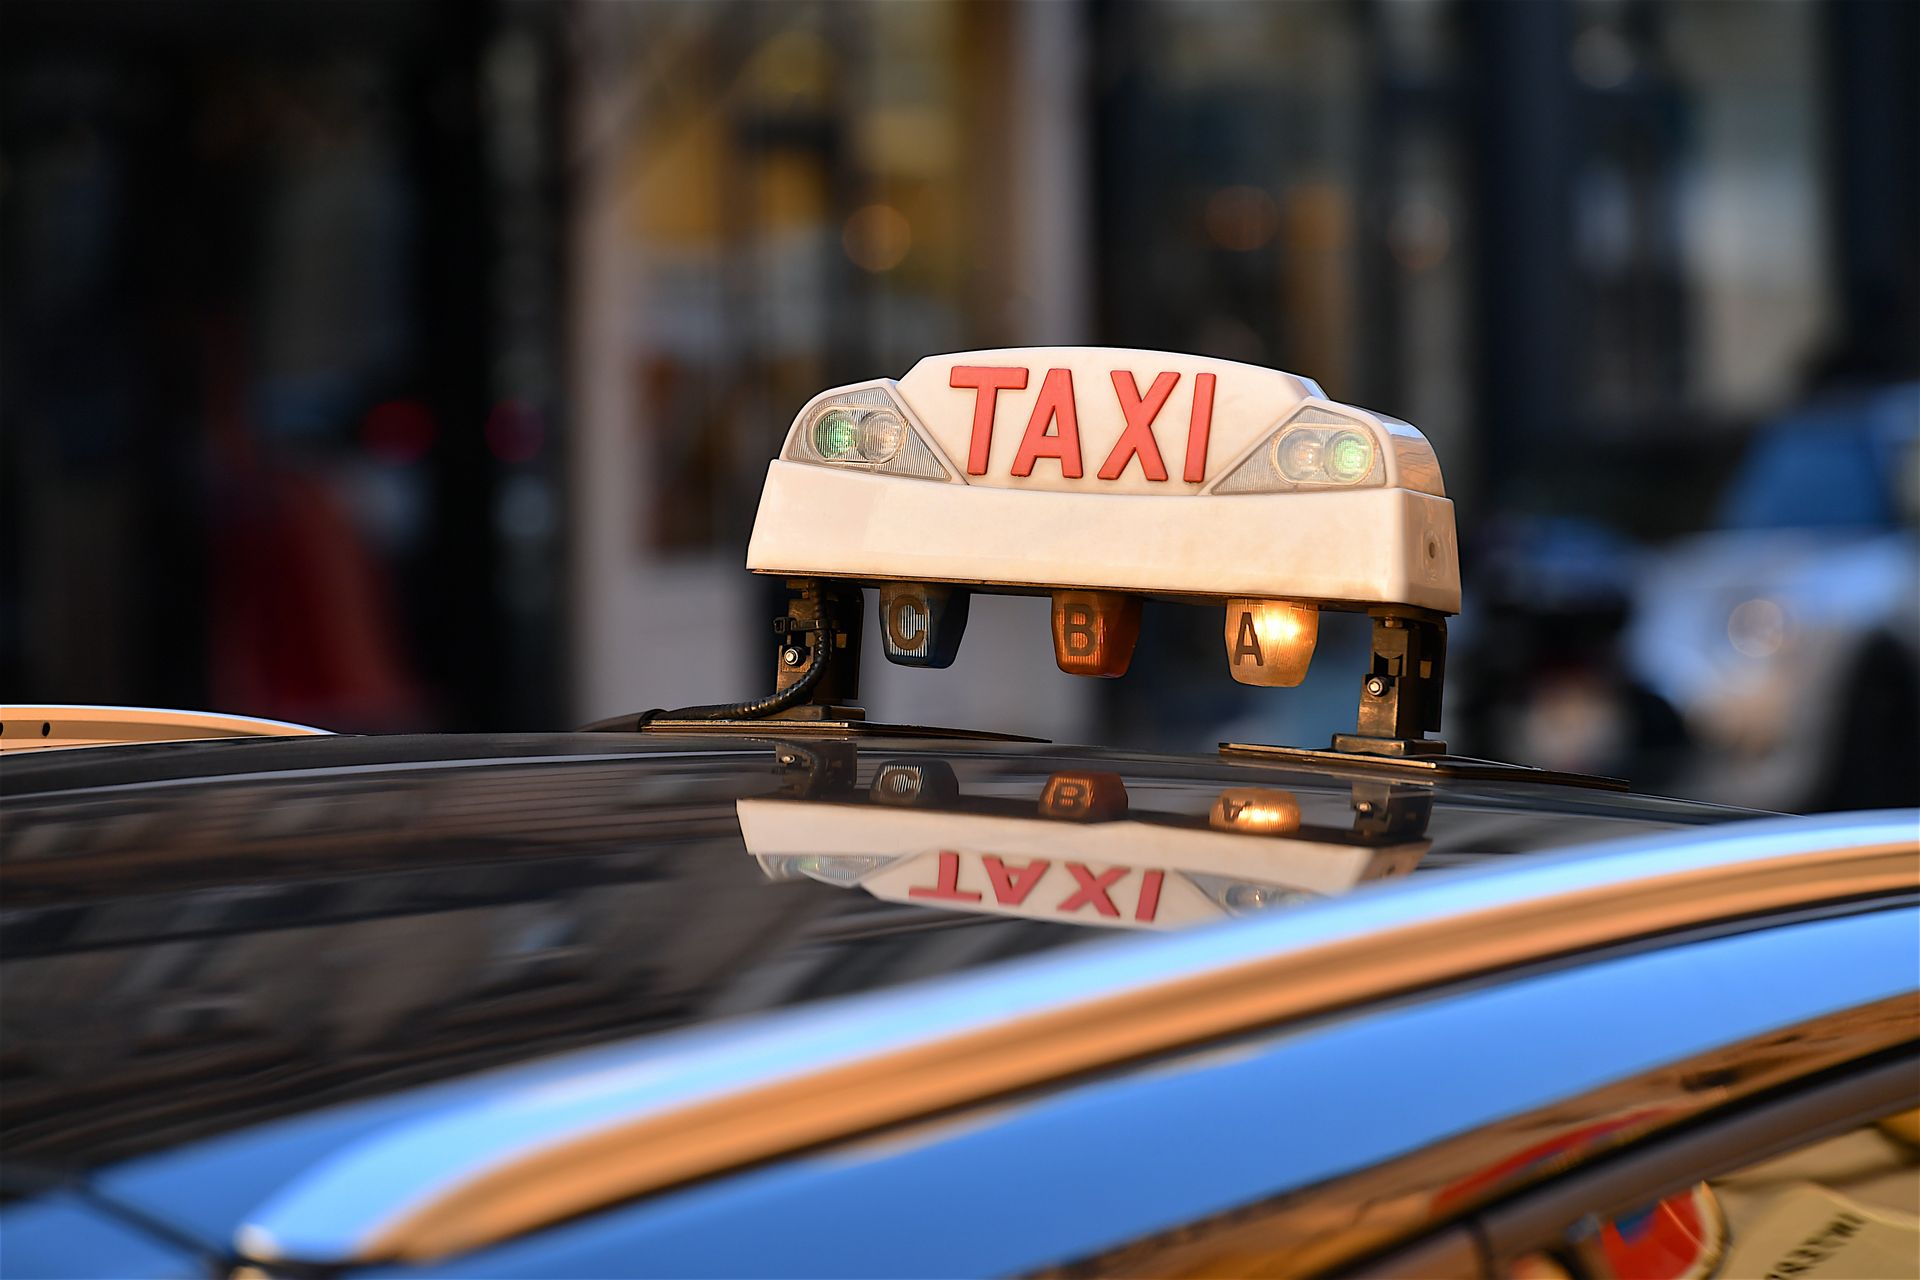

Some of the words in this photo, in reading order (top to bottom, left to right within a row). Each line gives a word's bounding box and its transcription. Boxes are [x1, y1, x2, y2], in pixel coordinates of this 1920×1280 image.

[950, 366, 1216, 483] TAXI
[890, 595, 926, 651] C
[1066, 603, 1098, 657] B
[1233, 612, 1265, 667] A
